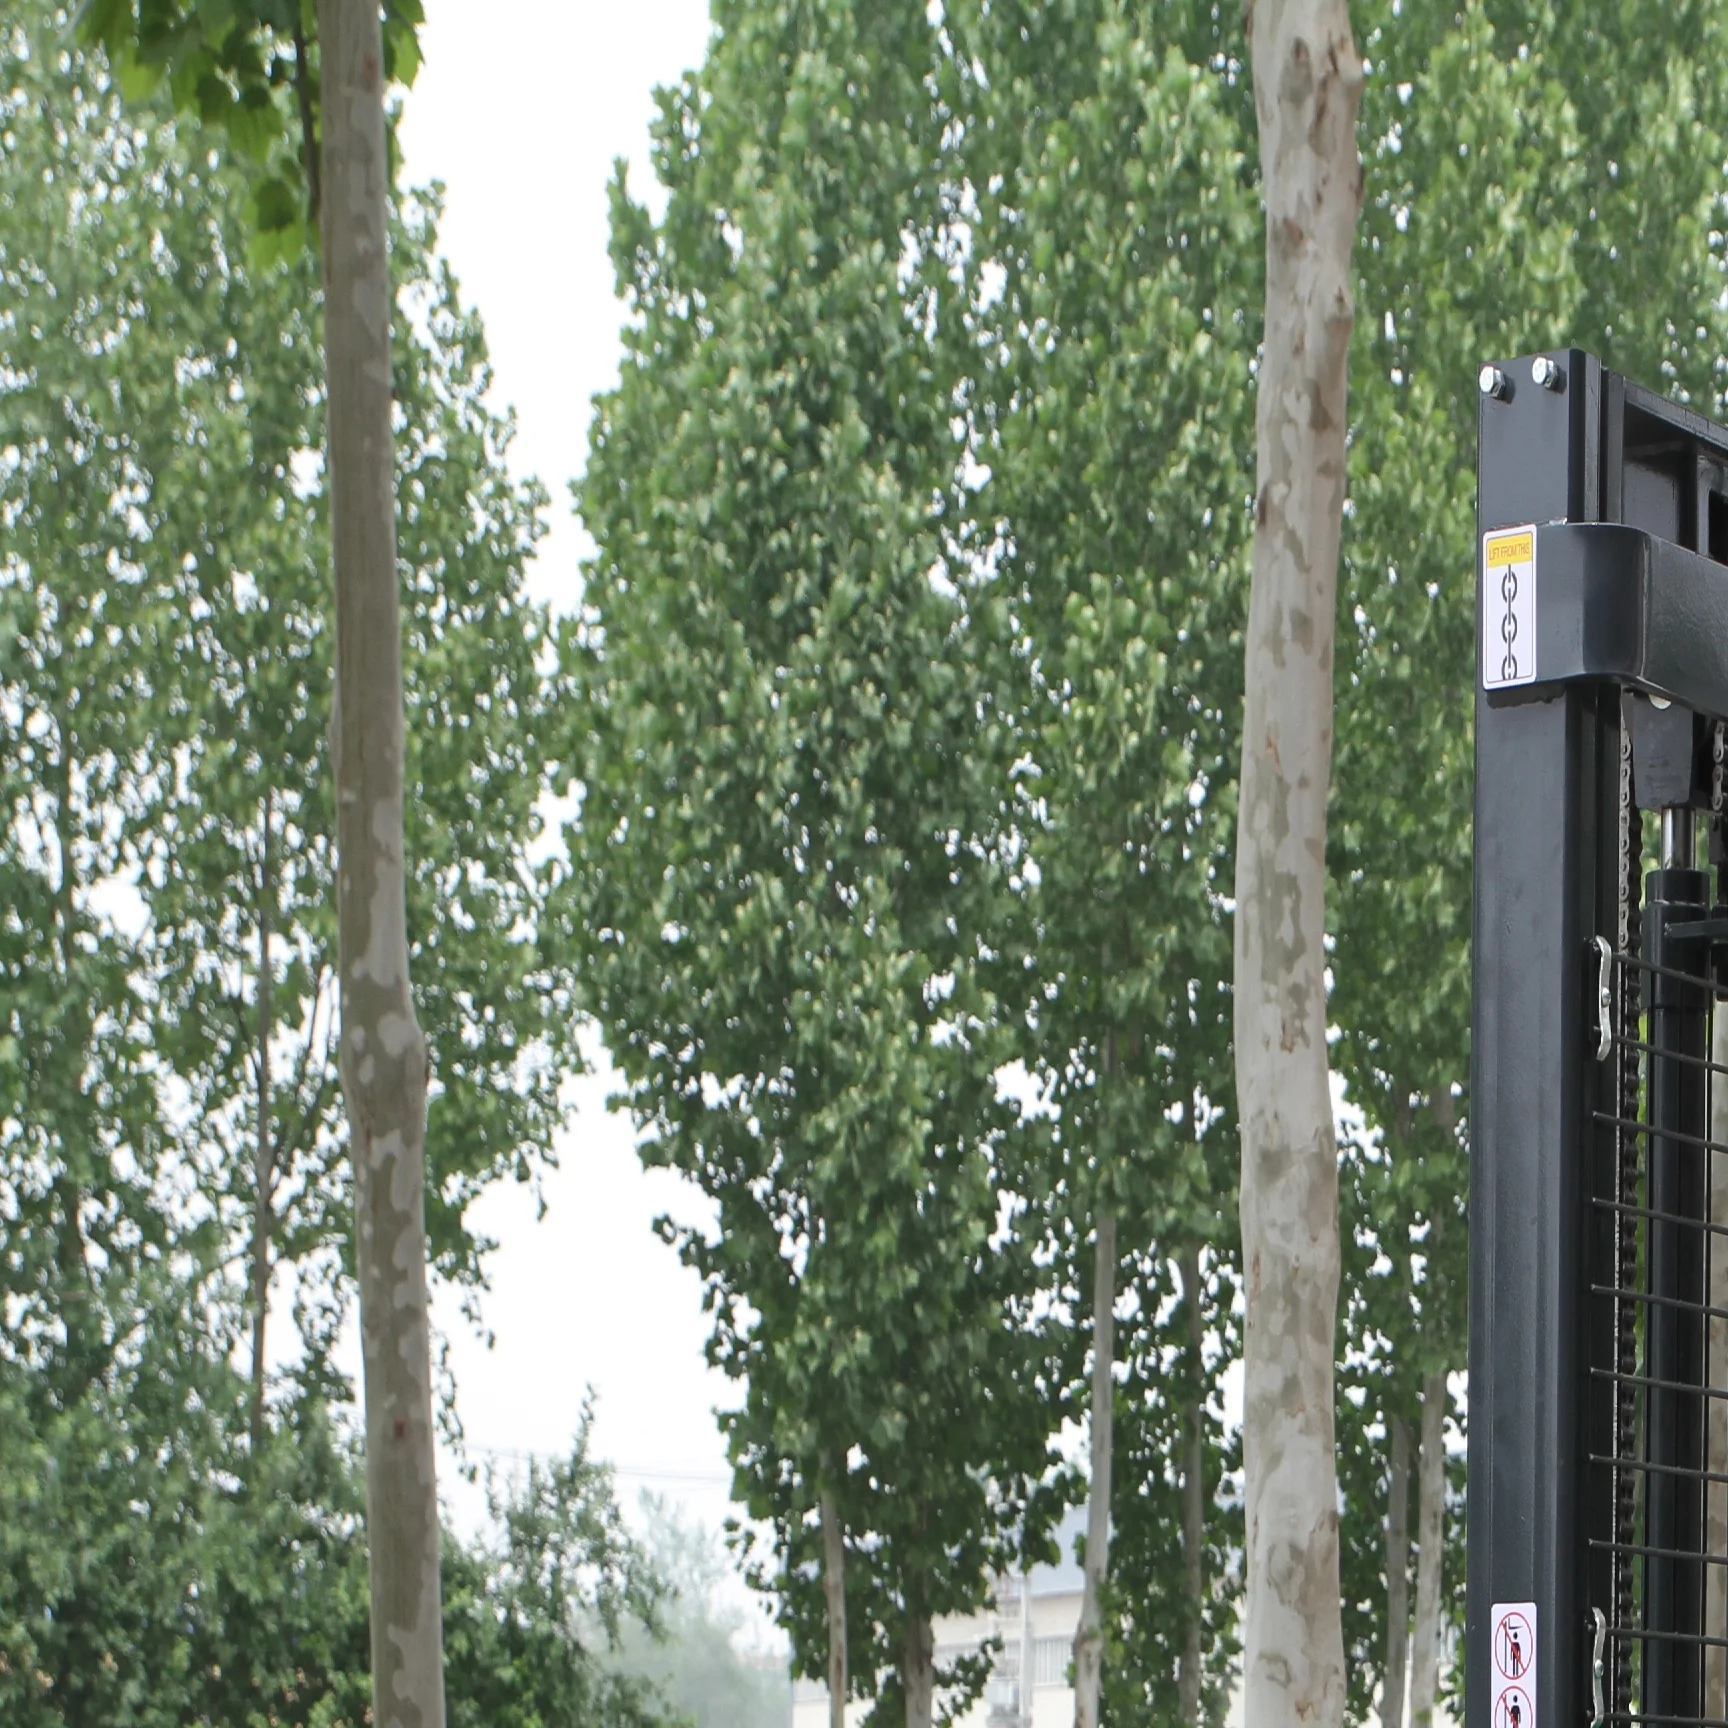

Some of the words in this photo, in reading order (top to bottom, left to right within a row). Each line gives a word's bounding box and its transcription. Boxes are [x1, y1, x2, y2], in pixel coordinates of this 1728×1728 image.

[1488, 546, 1500, 561] LIFT
[1500, 543, 1517, 558] FROM
[1517, 541, 1531, 556] THIS
